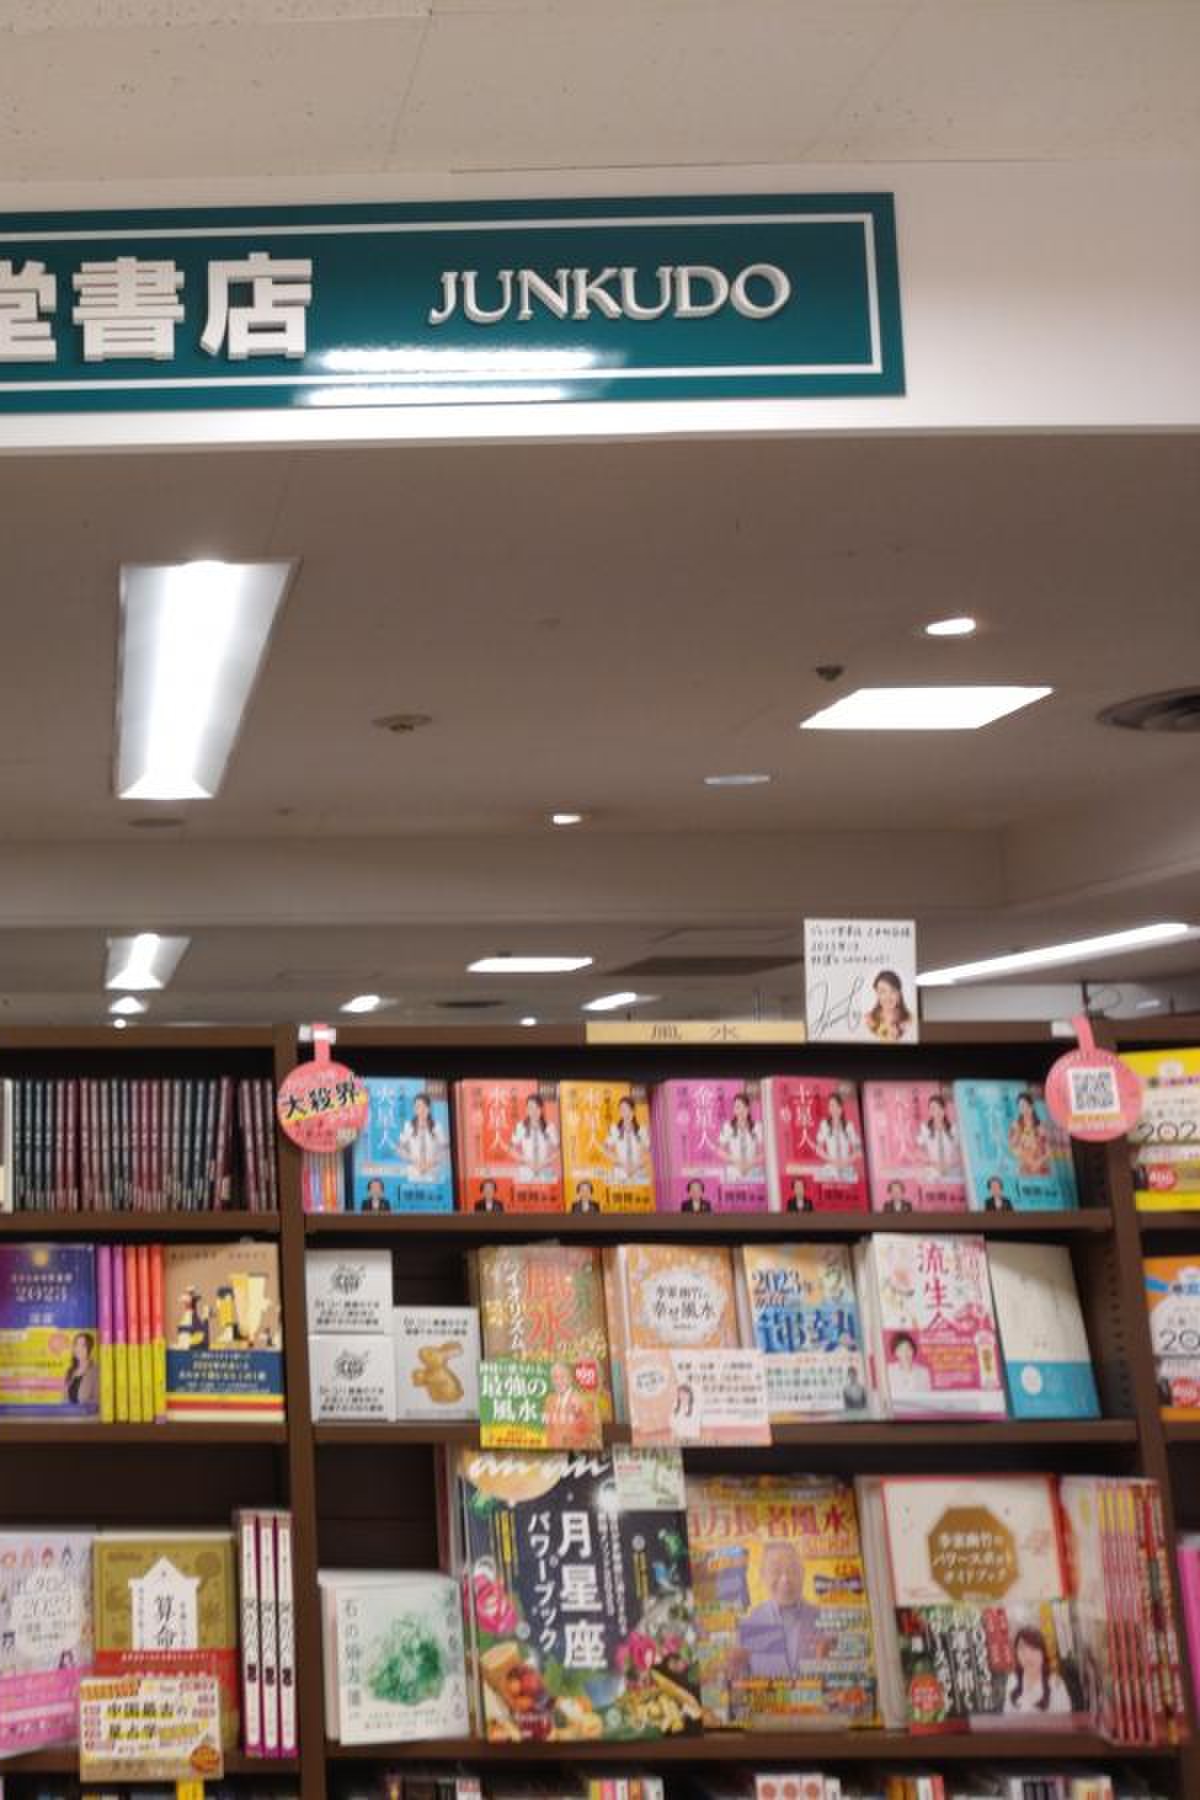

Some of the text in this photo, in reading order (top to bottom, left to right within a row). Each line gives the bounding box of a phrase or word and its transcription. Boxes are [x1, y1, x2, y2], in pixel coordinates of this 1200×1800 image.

[428, 263, 792, 326] JUNKUDO
[282, 1080, 360, 1119] 大殺界
[527, 1510, 558, 1652] パワーブック
[557, 1510, 608, 1669] 月星座
